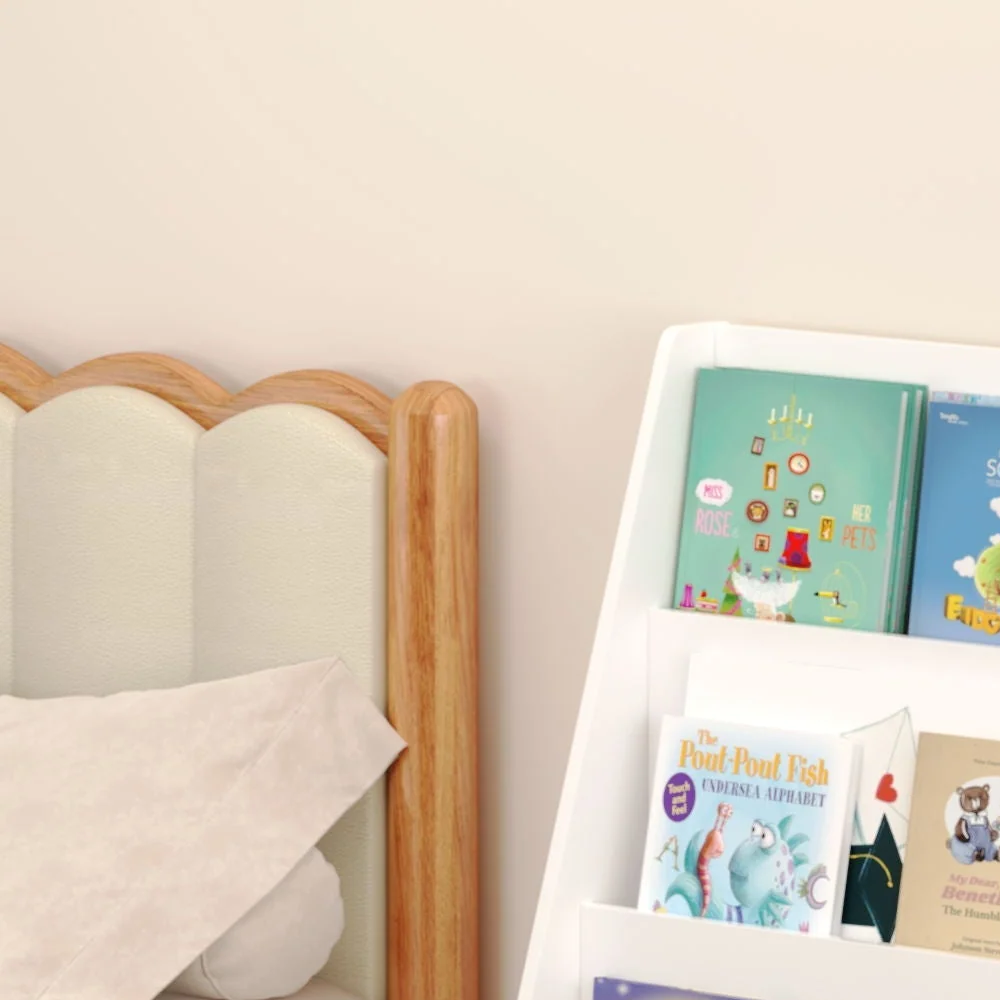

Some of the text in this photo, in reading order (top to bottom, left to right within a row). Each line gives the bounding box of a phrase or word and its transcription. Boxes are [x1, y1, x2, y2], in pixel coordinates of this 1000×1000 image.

[703, 484, 723, 500] MISS
[852, 504, 872, 523] HER
[694, 508, 733, 538] ROSE
[841, 525, 877, 551] PETS
[697, 728, 718, 746] The
[677, 739, 830, 788] Pout-Pout Fish
[667, 780, 690, 794] Touch
[701, 778, 828, 808] UNDERSEA ALPHABET
[672, 791, 687, 805] and
[671, 803, 688, 816] Feel
[949, 873, 967, 886] My
[942, 904, 962, 917] The
